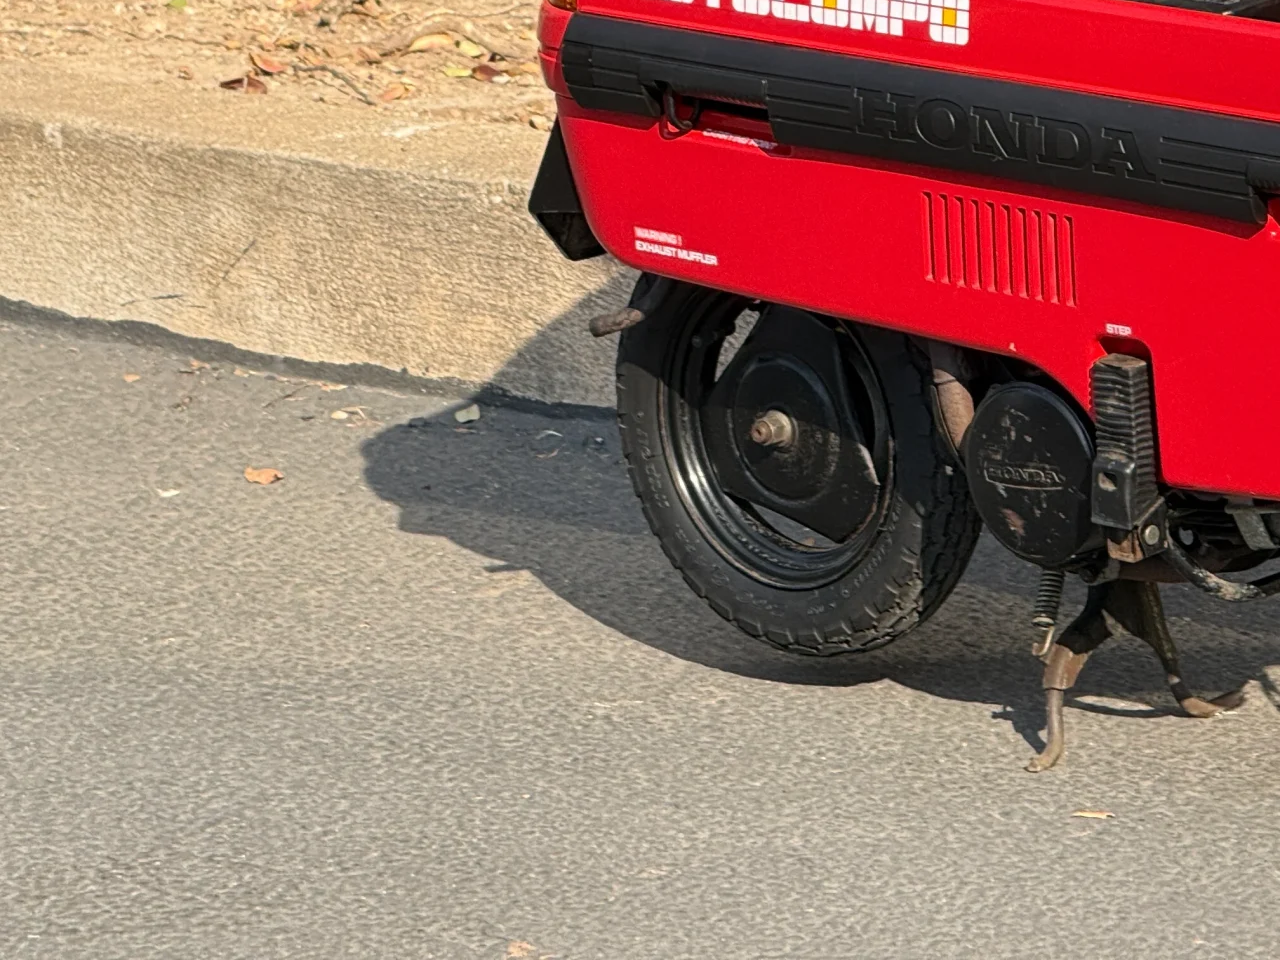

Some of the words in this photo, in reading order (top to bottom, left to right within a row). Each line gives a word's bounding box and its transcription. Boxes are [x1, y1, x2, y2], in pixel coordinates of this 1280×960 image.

[854, 87, 1156, 183] HONDA
[635, 240, 677, 257] EXHAUST
[677, 248, 718, 266] MUFFLER
[1106, 323, 1132, 335] STEP
